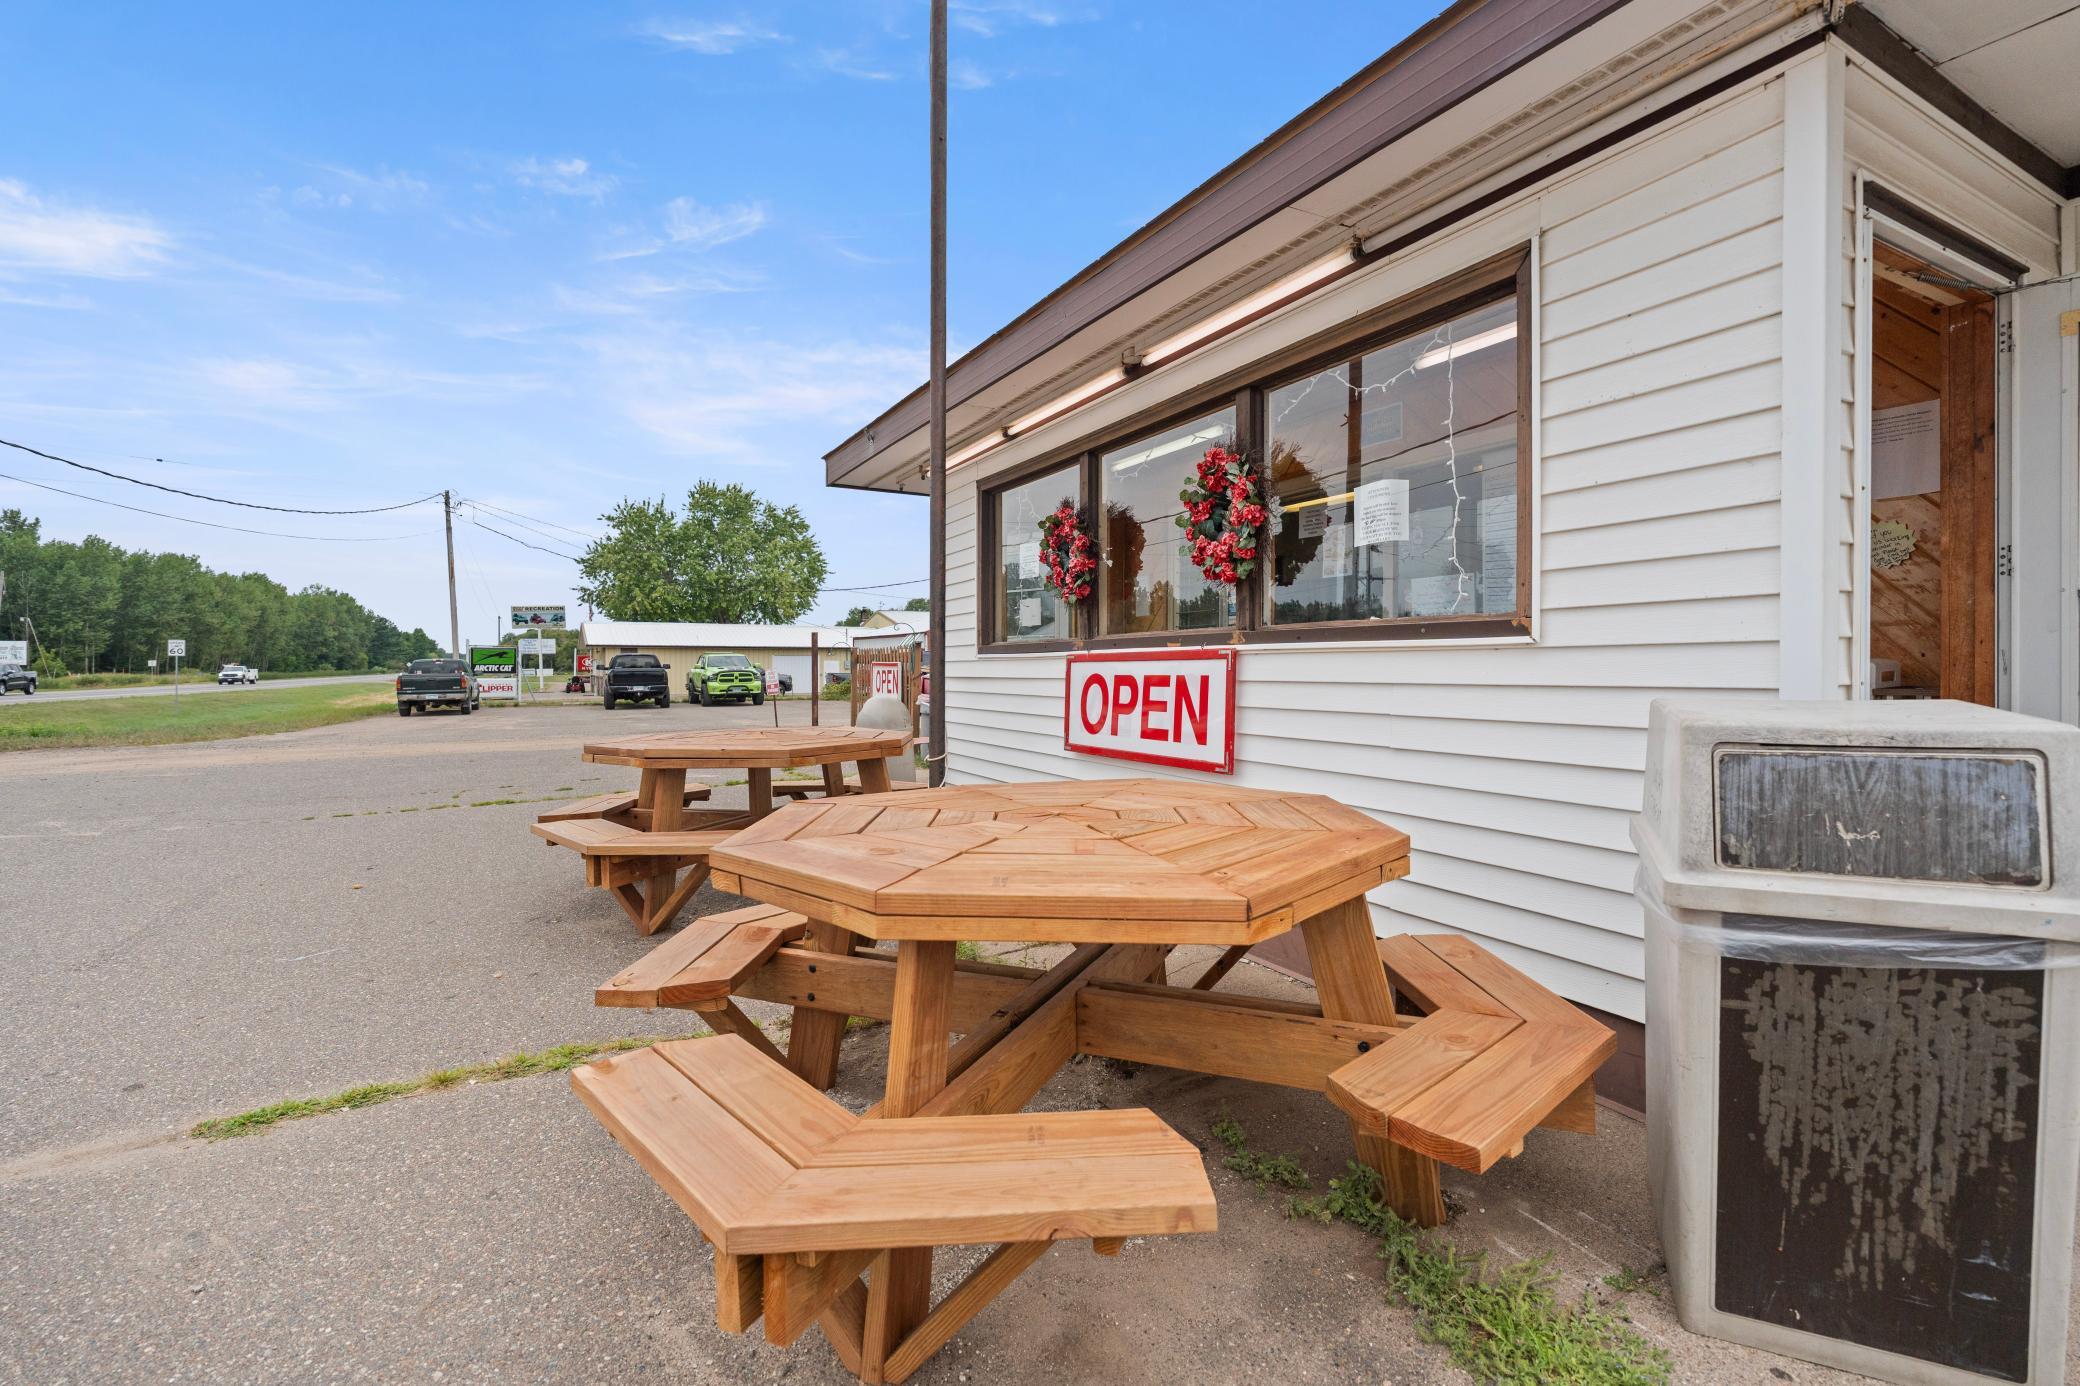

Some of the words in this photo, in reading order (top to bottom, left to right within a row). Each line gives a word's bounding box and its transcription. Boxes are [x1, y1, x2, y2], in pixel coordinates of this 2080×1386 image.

[474, 664, 500, 672] ARCTIC
[500, 664, 514, 672] CAT
[875, 669, 899, 695] OPEN
[1080, 672, 1210, 746] OPEN
